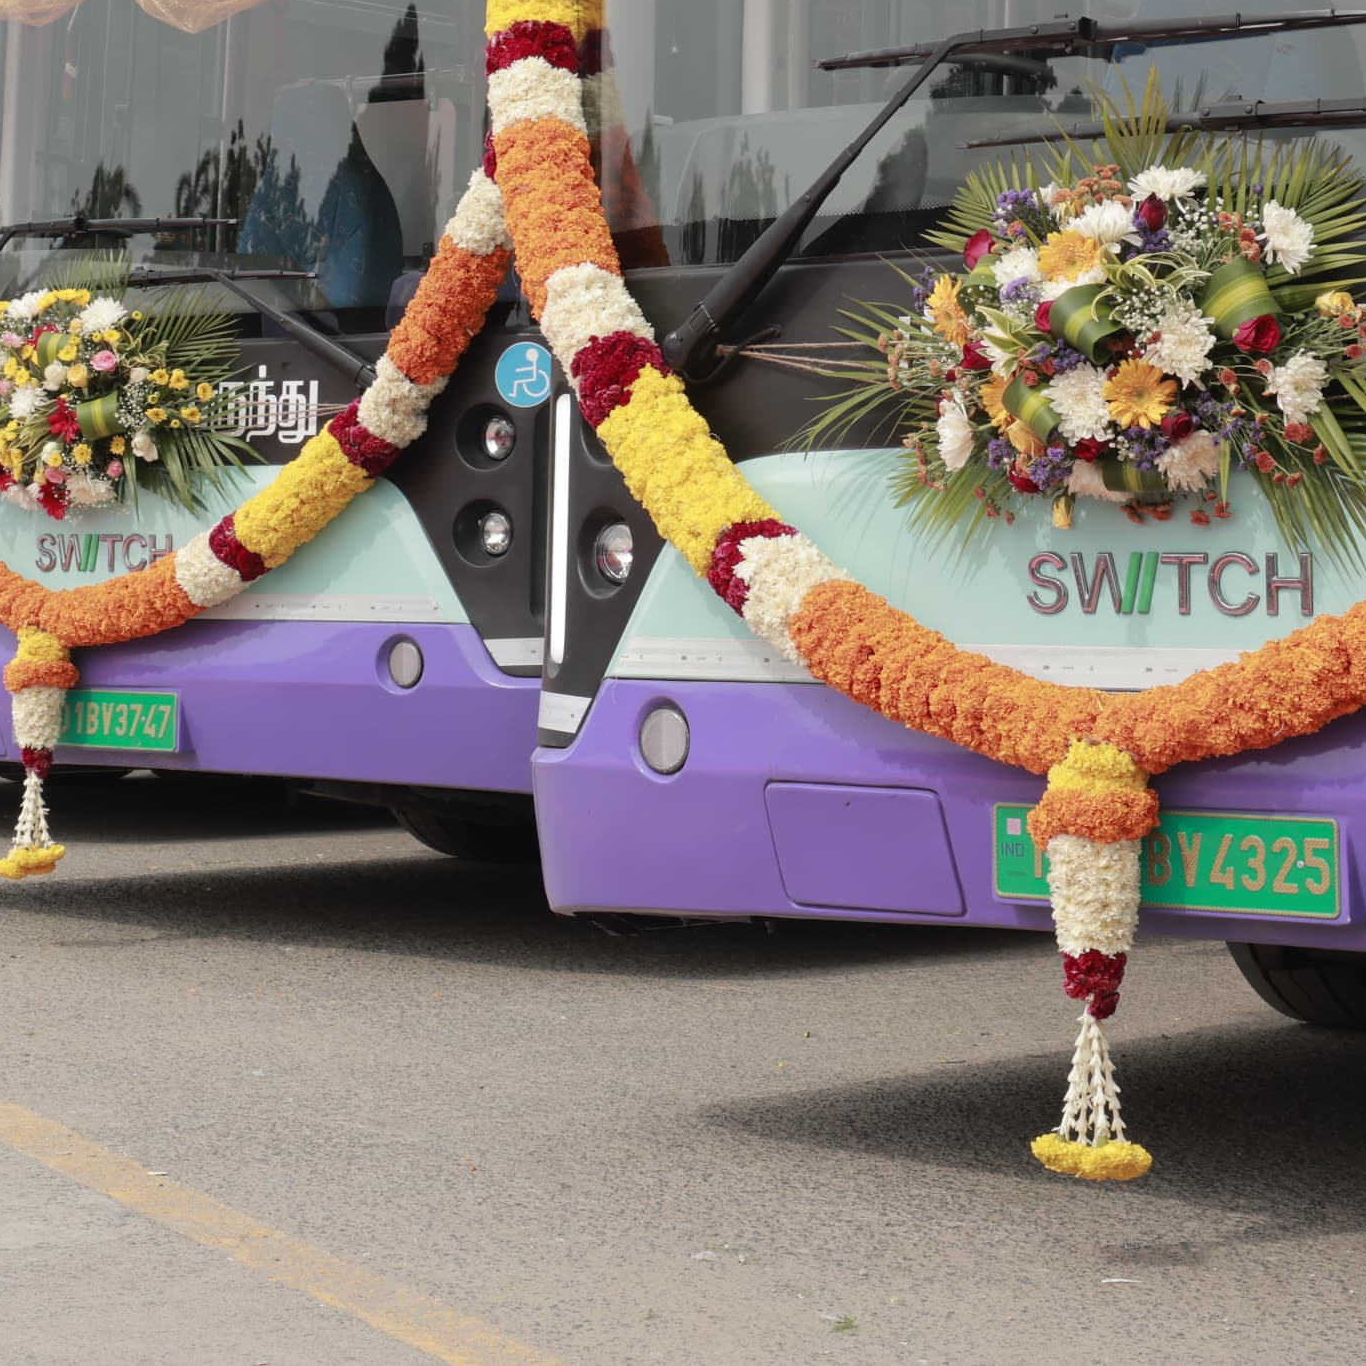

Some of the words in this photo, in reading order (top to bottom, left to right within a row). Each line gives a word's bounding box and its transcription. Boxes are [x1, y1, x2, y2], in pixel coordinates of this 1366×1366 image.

[35, 532, 173, 573] SWITCH
[1025, 550, 1315, 617] SWITCH
[1001, 841, 1026, 859] IND
[1146, 831, 1332, 896] BV4325
